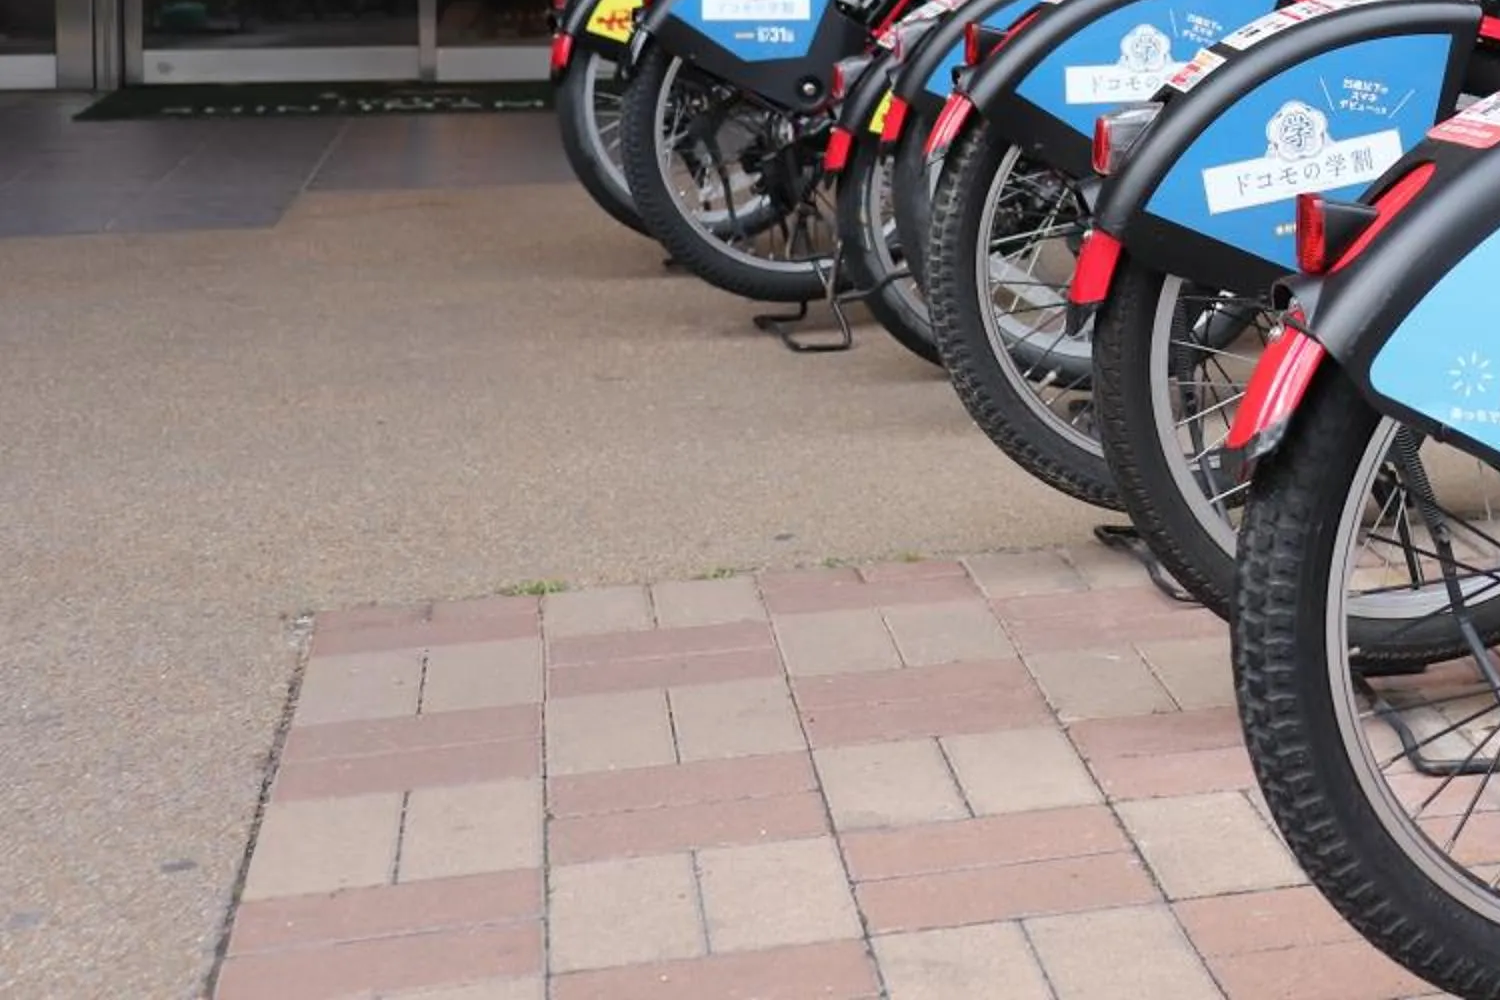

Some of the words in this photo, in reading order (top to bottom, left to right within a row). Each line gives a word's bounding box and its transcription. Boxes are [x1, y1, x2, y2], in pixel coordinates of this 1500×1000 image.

[1236, 147, 1374, 196] ドコモの学割
